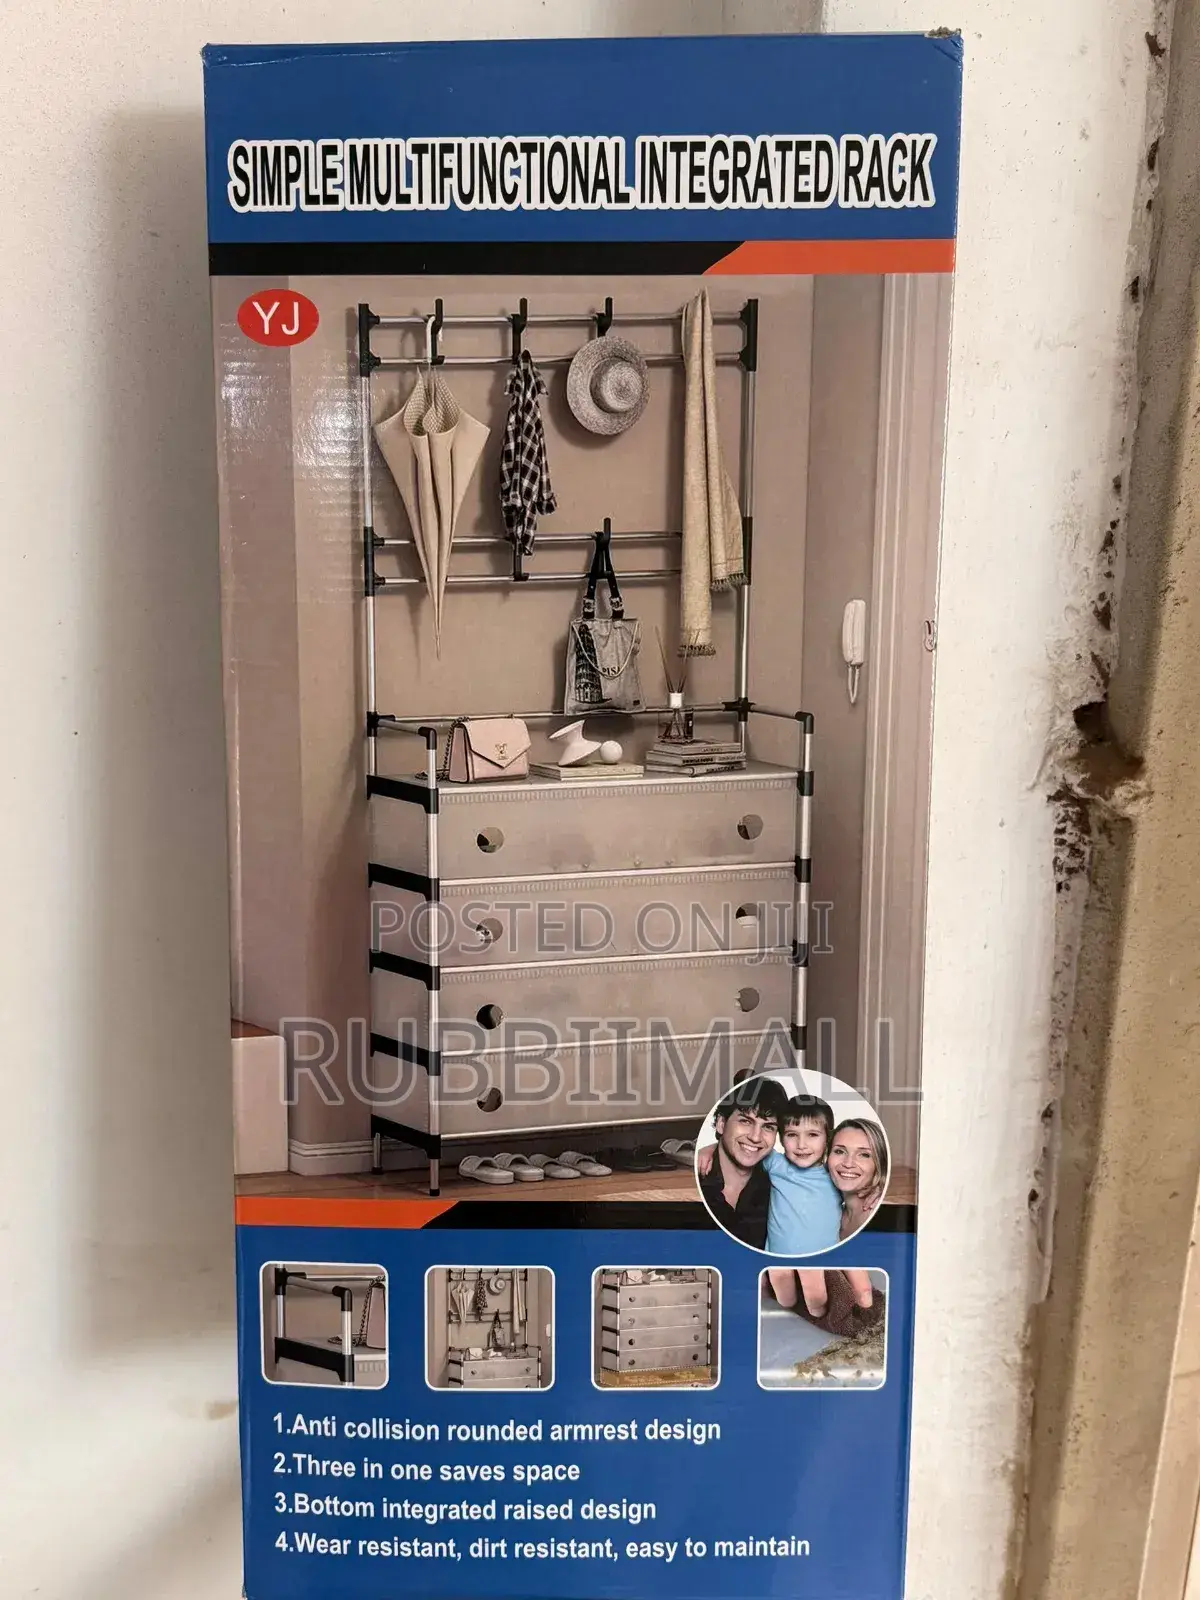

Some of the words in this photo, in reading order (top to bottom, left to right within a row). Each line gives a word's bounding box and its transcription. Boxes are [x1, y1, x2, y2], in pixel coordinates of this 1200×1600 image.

[230, 142, 341, 209] SIMPLE
[348, 138, 632, 208] MULTIFUNCTIONAL
[638, 138, 835, 206] INTEGRATED
[842, 136, 935, 205] RACK
[251, 301, 300, 335] YJ
[273, 1412, 337, 1437] 1.Anti
[343, 1418, 440, 1440] collision
[447, 1419, 543, 1441] rounded
[550, 1419, 638, 1440] armrest
[644, 1418, 721, 1445] design
[273, 1452, 356, 1478] 2.Three
[362, 1457, 383, 1479] in
[390, 1463, 432, 1480] one
[439, 1464, 505, 1481] saves
[512, 1464, 580, 1486] space
[274, 1492, 375, 1518] 3.Bottom
[382, 1497, 496, 1525] integrated
[503, 1499, 573, 1520] raised
[580, 1499, 657, 1525] design
[274, 1531, 352, 1554] 4.Wear
[358, 1536, 462, 1562] resistant,
[469, 1537, 507, 1558] dirt
[513, 1537, 618, 1561] resistant,
[625, 1541, 678, 1563] easy
[684, 1537, 707, 1557] to
[714, 1535, 810, 1557] maintain
